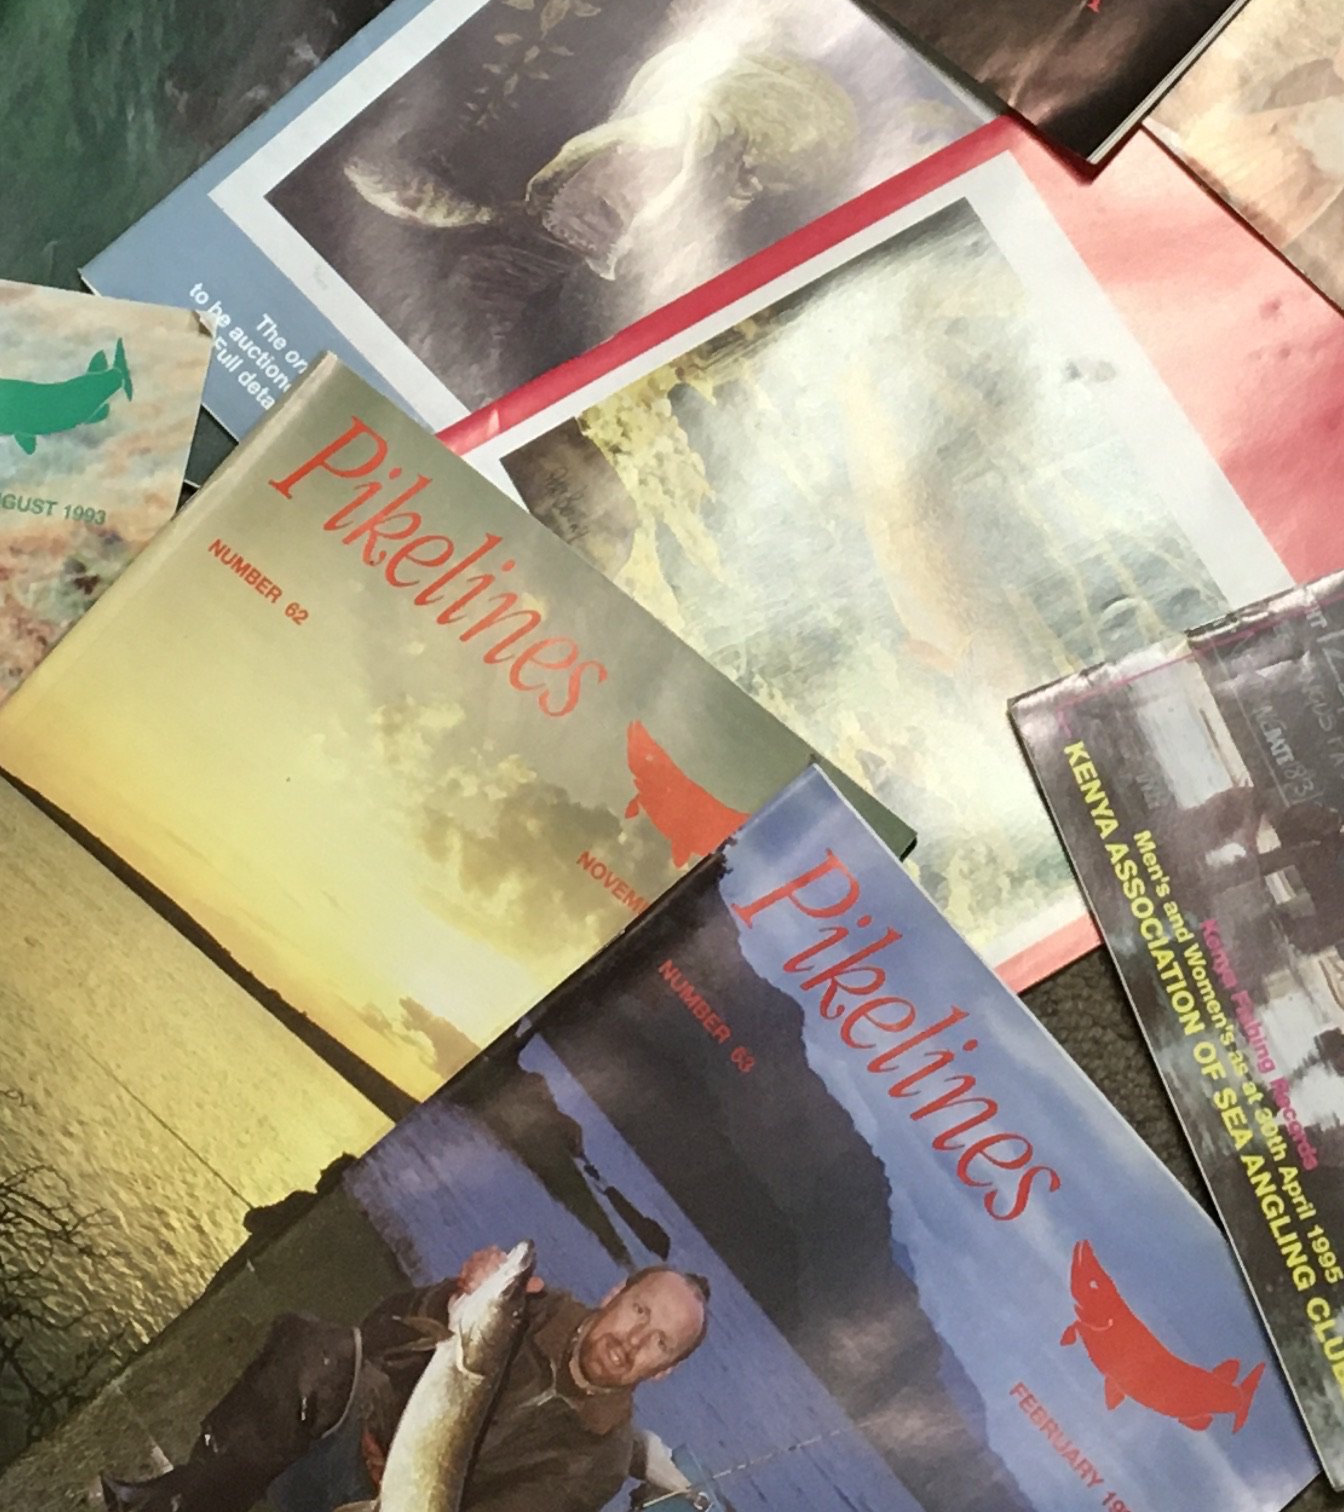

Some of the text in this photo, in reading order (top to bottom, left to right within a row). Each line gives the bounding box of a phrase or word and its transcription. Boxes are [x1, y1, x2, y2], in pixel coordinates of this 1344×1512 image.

[189, 282, 210, 305] to
[256, 313, 287, 351] The
[63, 503, 107, 526] 1993
[268, 414, 608, 717] Pikelines
[208, 538, 309, 626] NUMBER 62
[658, 959, 732, 1044] NUMBER
[731, 847, 1061, 1222] Pikelines
[1063, 740, 1119, 840] KENYA
[1104, 841, 1206, 1036] ASSOCIATION
[1192, 1041, 1227, 1081] OF
[1212, 1087, 1254, 1151] SEA
[1240, 1154, 1317, 1292] ANGLING
[1200, 918, 1319, 1172] Kenya Fishing Records
[1133, 829, 1171, 899] Men's
[1163, 900, 1194, 943] and
[1183, 942, 1235, 1046] Women's
[1227, 1048, 1249, 1077] as
[1242, 1080, 1264, 1105] at
[1278, 1165, 1317, 1220] April
[1306, 1224, 1344, 1285] 1995
[1008, 1381, 1105, 1488] FEBRUARY
